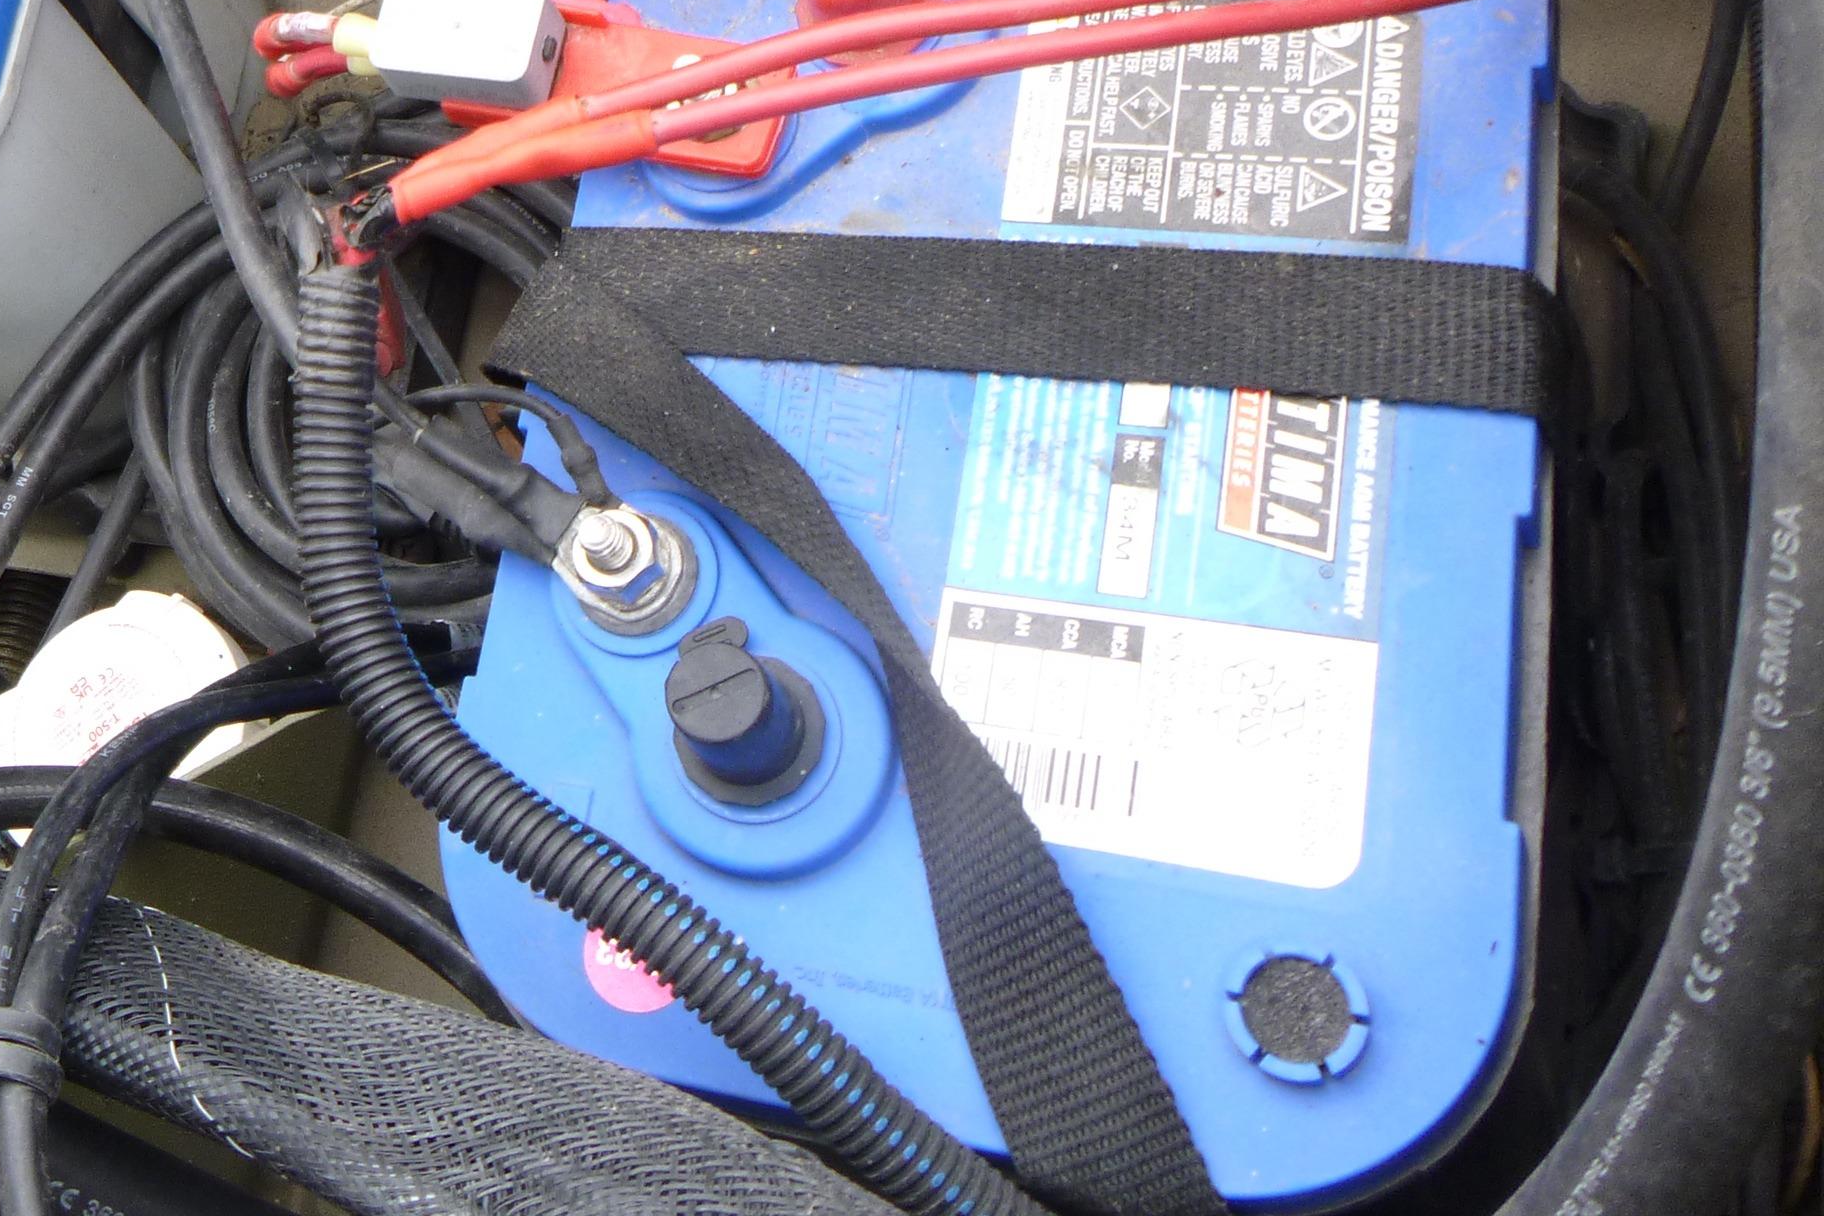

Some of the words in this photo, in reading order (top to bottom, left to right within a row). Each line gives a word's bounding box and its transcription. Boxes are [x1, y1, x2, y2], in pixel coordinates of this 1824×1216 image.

[1283, 51, 1302, 83] EYES.
[1102, 76, 1119, 105] HELP
[1281, 95, 1300, 114] NO
[1097, 106, 1116, 136] FAST.
[1206, 101, 1224, 151] SMOKING
[1230, 101, 1250, 146] FLAMES
[1254, 102, 1273, 146] SPARKS
[1361, 42, 1403, 232] DANGER/POISON
[1068, 130, 1084, 149] DO
[1108, 155, 1127, 195] REACH
[1130, 156, 1145, 172] OF
[1144, 157, 1163, 186] KEEP
[1176, 161, 1196, 199] BURNS.
[1198, 161, 1213, 178] OR
[1233, 163, 1251, 189] CAN
[1253, 164, 1272, 194] ACID
[1059, 175, 1076, 212] OPEN.
[1125, 174, 1142, 196] THE
[1142, 188, 1159, 213] OUT
[1193, 179, 1211, 220] SEVERE
[1270, 164, 1293, 226] SULFURIC
[1107, 195, 1123, 212] OF
[1231, 189, 1250, 224] CAUSE
[1264, 400, 1329, 537] TIMA
[0, 494, 16, 518] SGT
[1351, 472, 1372, 519] AGM
[1770, 505, 1804, 582] USA
[1343, 522, 1369, 618] BATTERY
[967, 606, 984, 630] RC
[1014, 612, 1031, 637] AH
[1060, 618, 1080, 650] CCA
